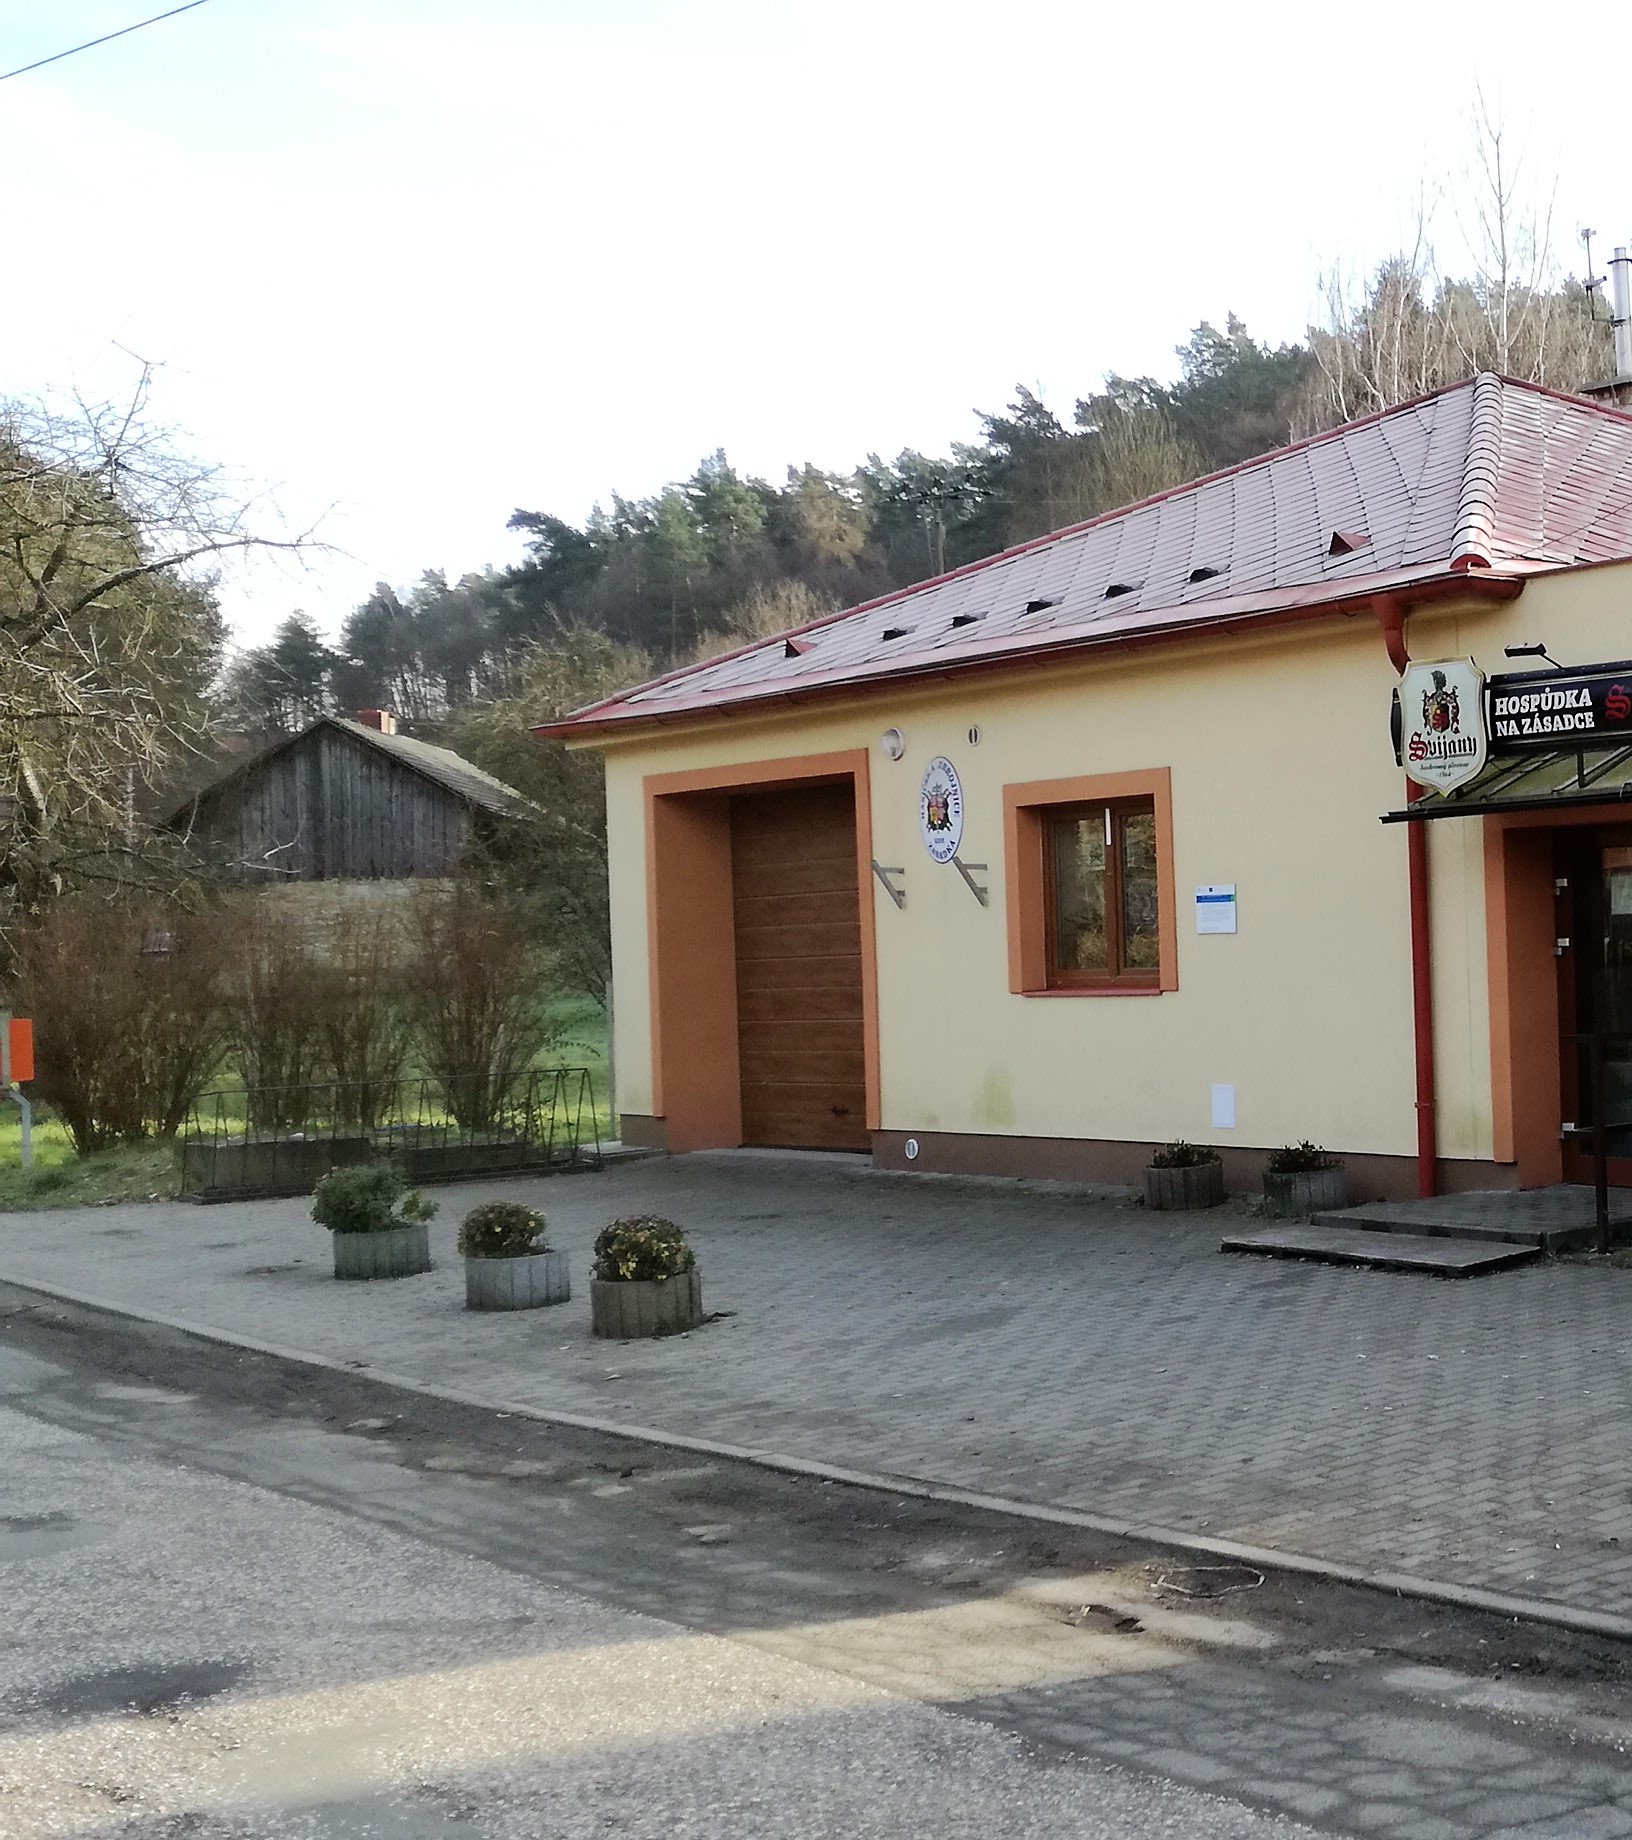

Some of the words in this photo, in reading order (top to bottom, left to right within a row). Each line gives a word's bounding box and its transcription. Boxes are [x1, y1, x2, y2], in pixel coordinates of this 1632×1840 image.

[1494, 686, 1593, 716] HOSPŮDKA
[1496, 719, 1520, 737] NA
[1521, 712, 1595, 735] ZÁSADCE
[1408, 731, 1477, 762] Svijany
